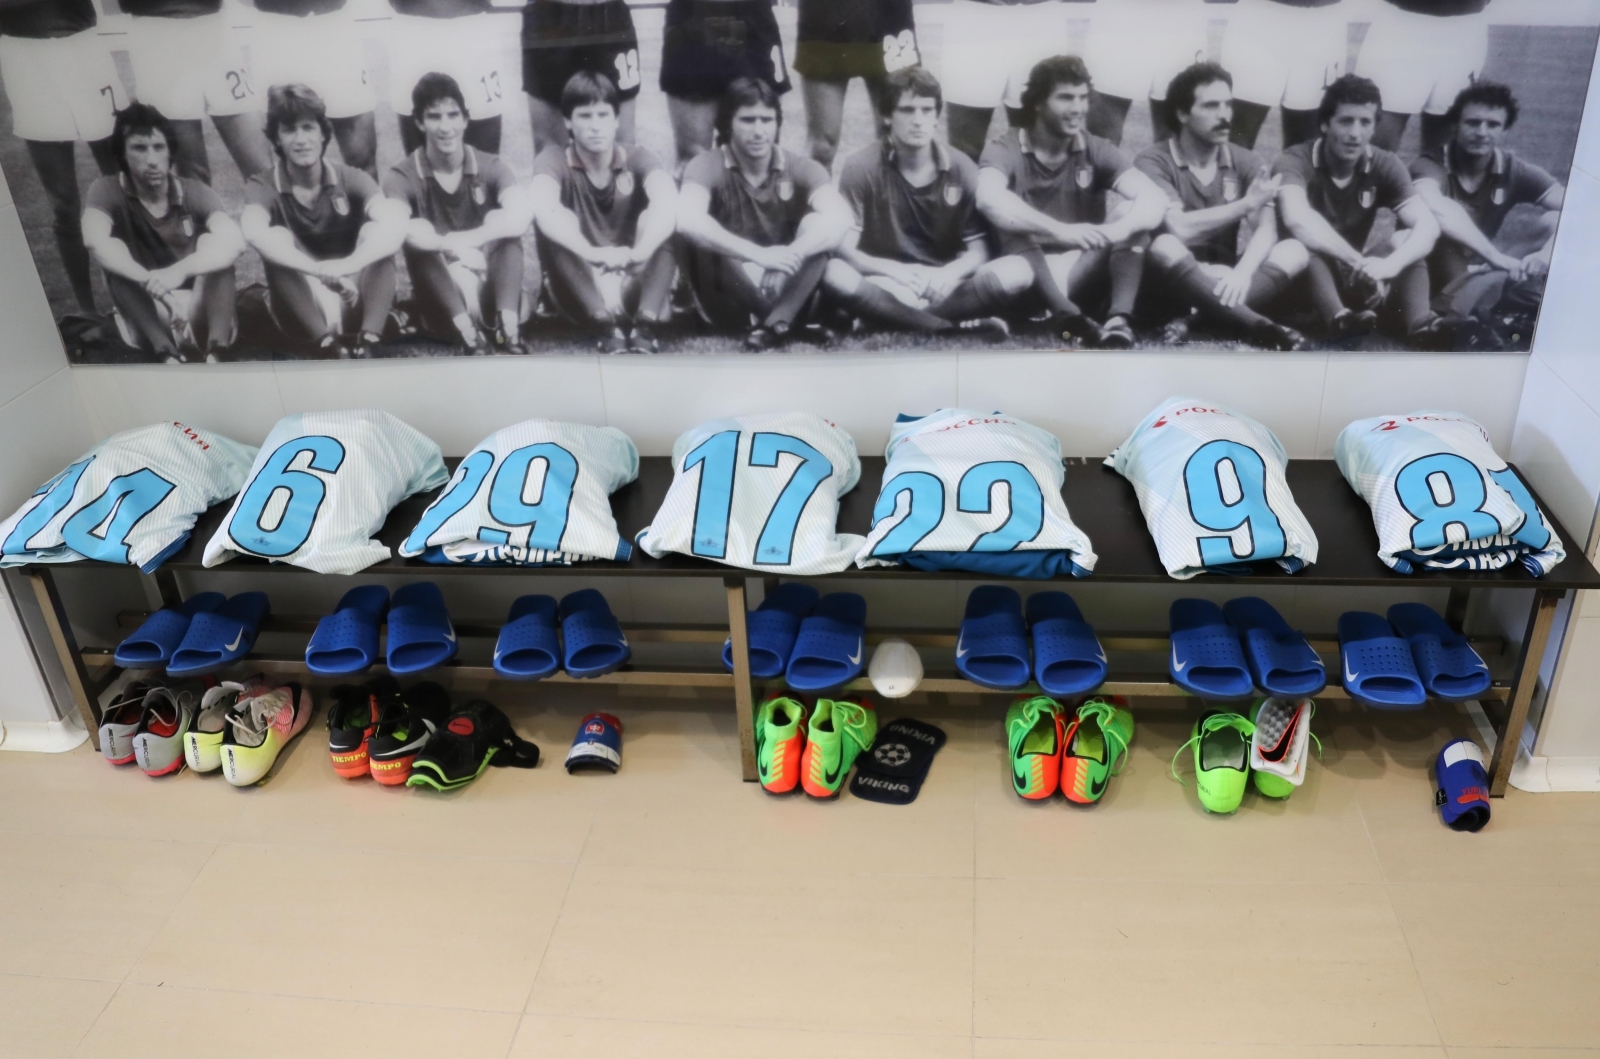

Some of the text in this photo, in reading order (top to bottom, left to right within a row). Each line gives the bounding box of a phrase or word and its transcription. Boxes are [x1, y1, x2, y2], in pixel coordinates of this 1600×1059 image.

[173, 421, 210, 450] СИЯ
[228, 434, 345, 557] 6
[404, 441, 579, 552] 29
[683, 430, 833, 565] 17
[871, 460, 1045, 553] 22
[1183, 439, 1287, 566] 9
[331, 751, 367, 763] TIEMPO
[858, 776, 910, 793] VIKING
